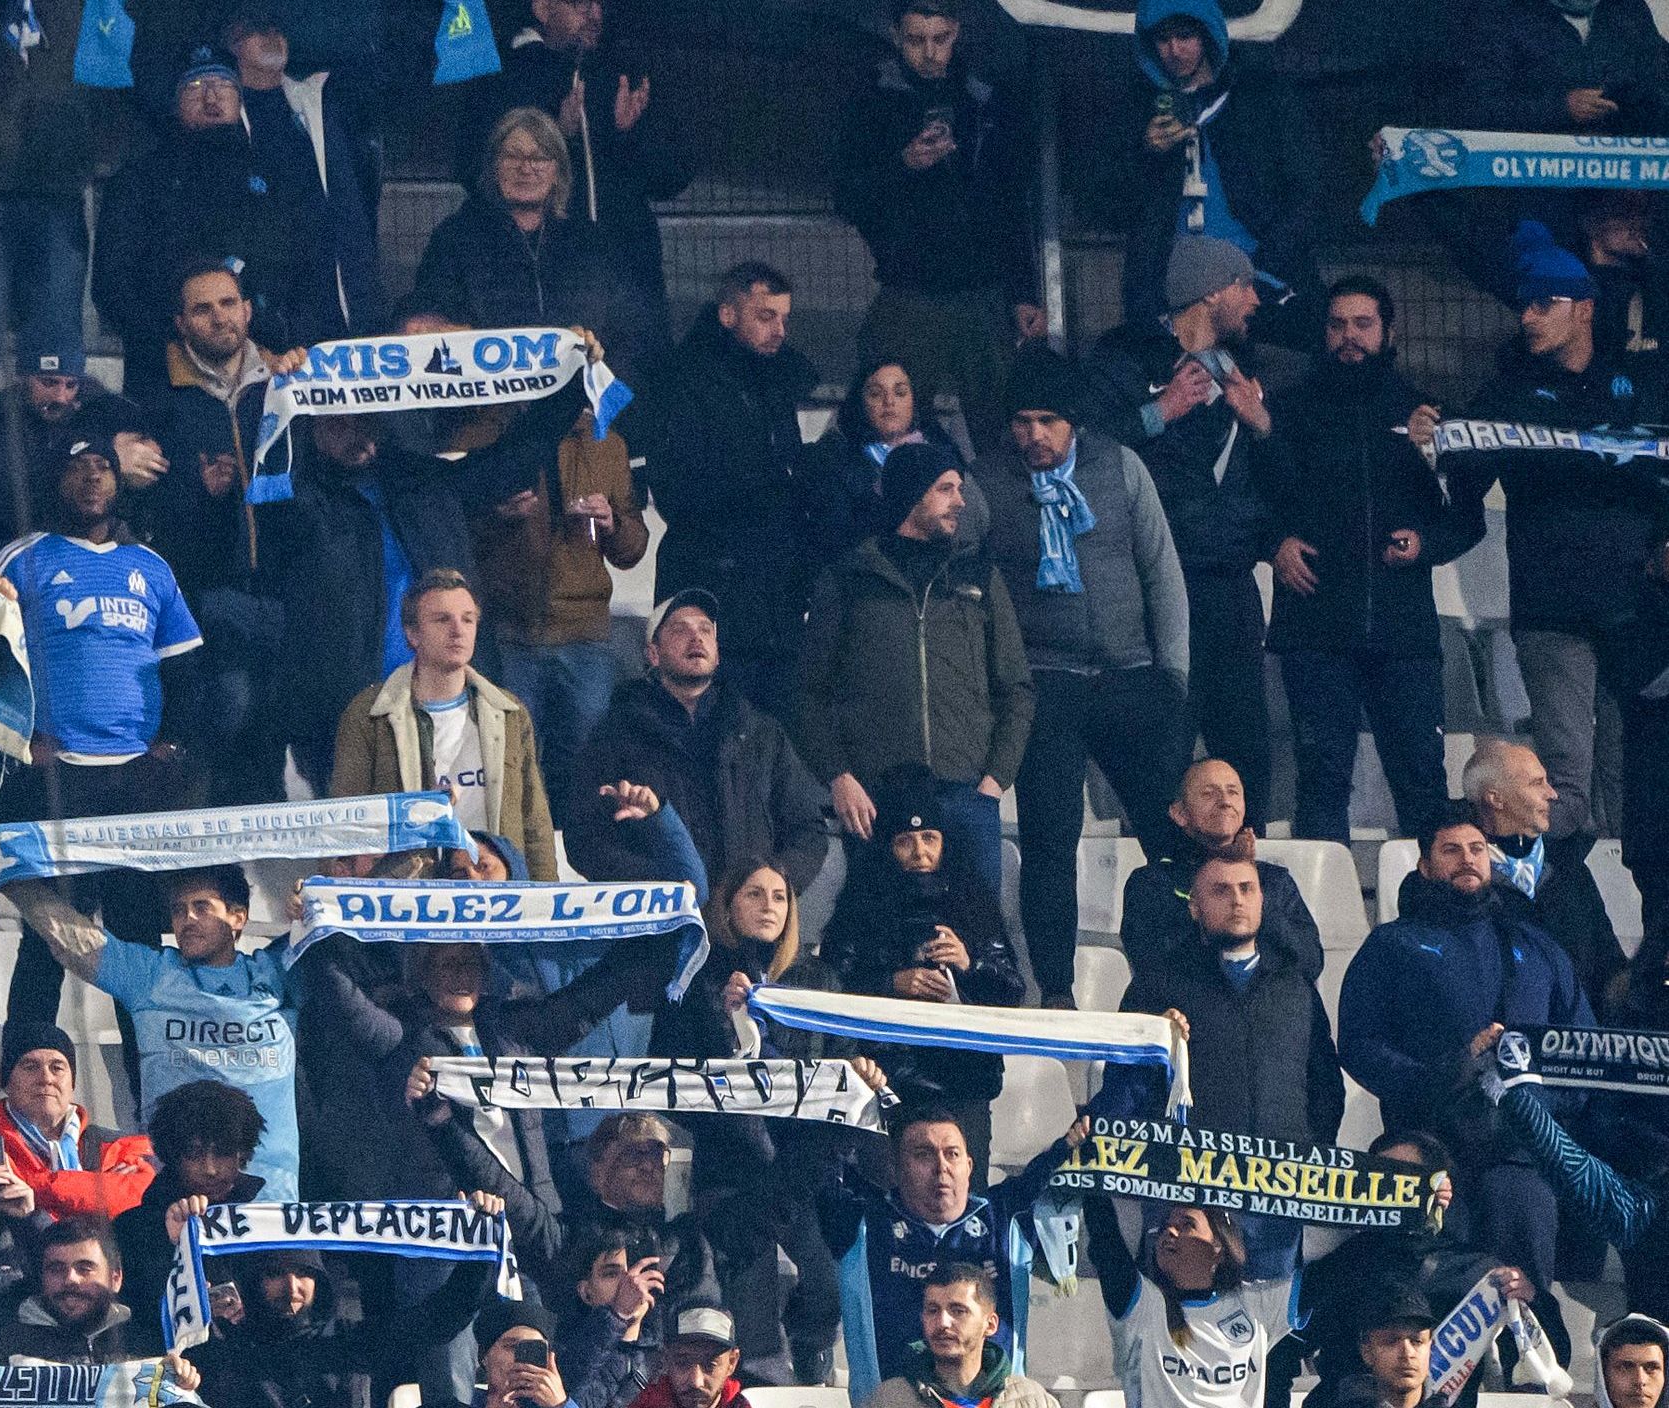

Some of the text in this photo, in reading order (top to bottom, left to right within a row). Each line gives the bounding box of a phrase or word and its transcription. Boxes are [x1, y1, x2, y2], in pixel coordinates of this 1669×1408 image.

[1491, 155, 1632, 182] OLYMPIQUE
[472, 333, 561, 373] OM
[406, 377, 488, 402] VIRAGE
[492, 373, 557, 396] NORD
[101, 611, 150, 631] SPORT
[337, 889, 684, 924] ALLEZ L'OM
[1153, 1122, 1357, 1169] MARSEILLAIS
[1177, 1146, 1421, 1209] MARSEILLE
[1103, 1175, 1403, 1227] SOMMES LES MARSEILLAIS
